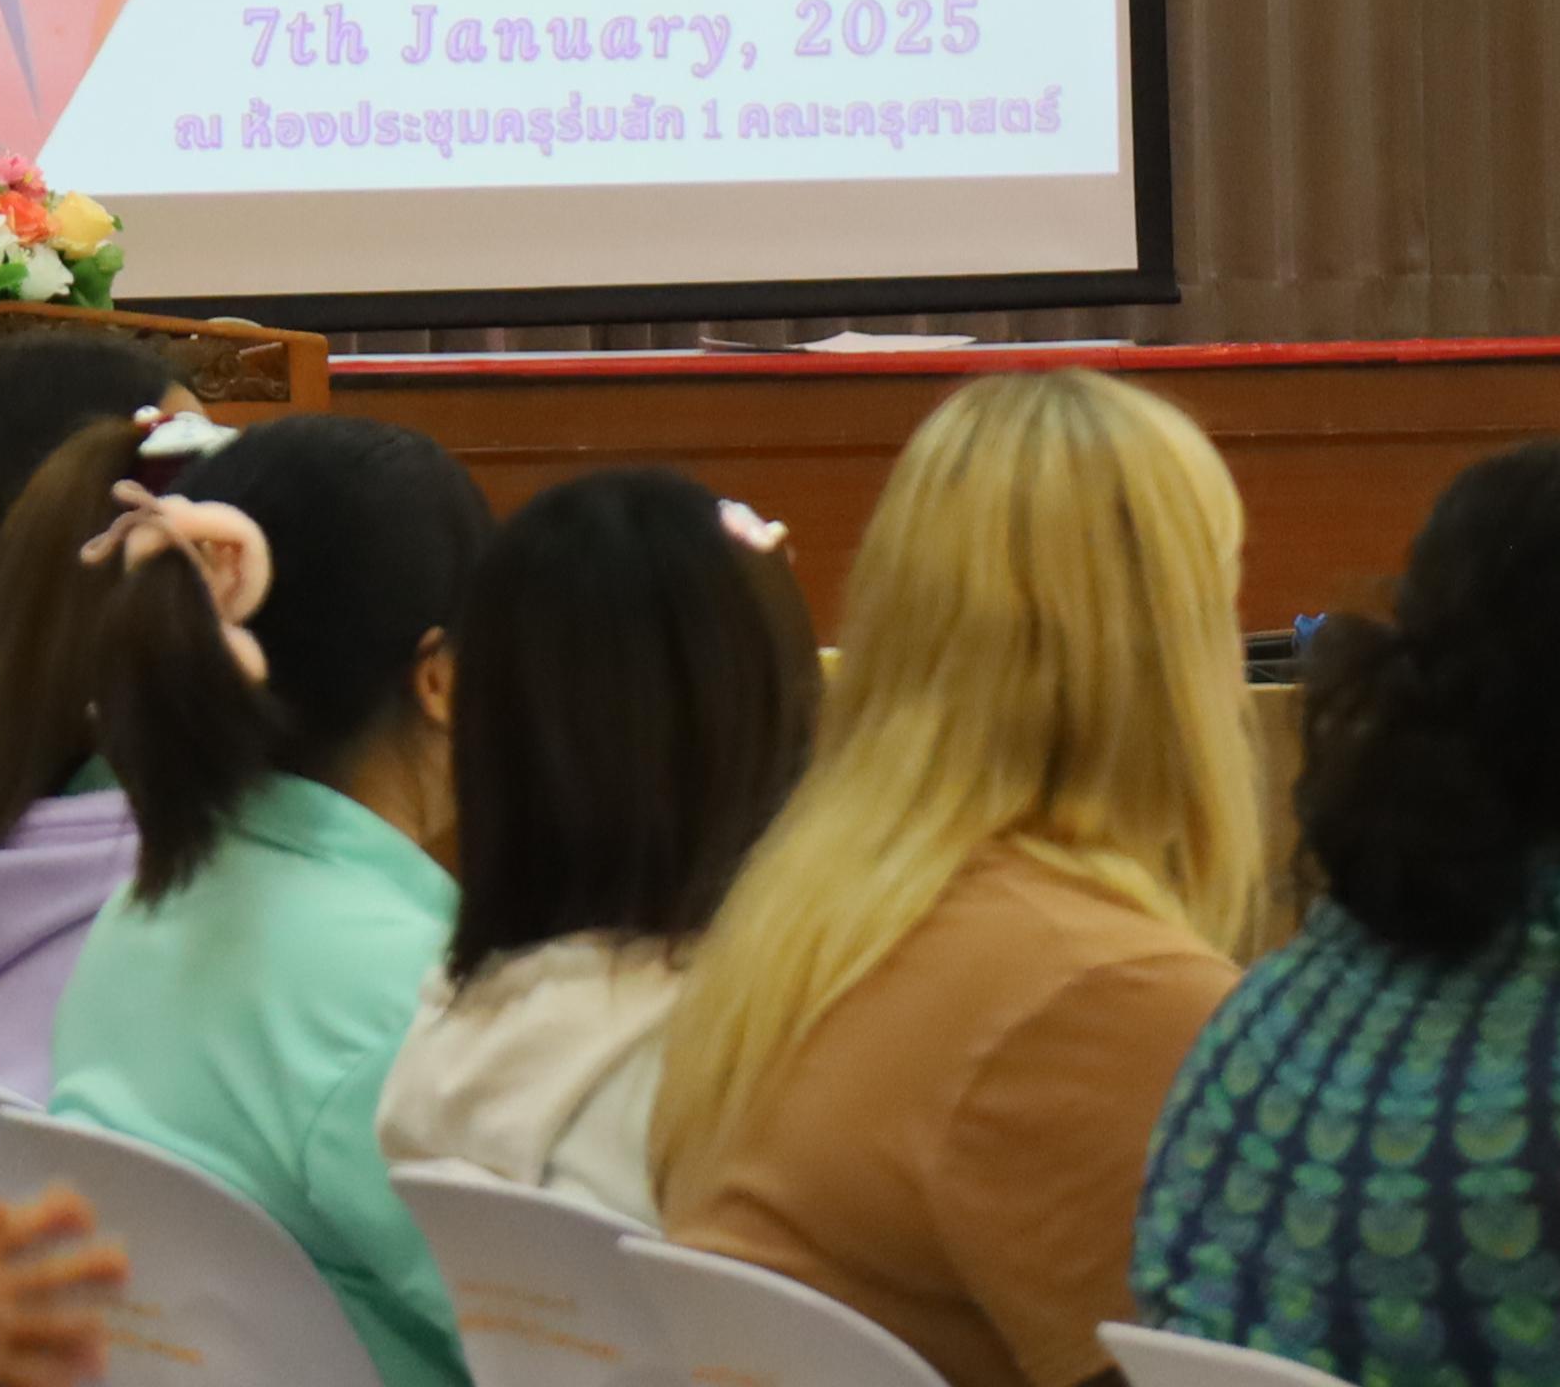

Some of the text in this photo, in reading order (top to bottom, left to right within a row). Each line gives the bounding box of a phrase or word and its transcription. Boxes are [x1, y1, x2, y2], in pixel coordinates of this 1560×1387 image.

[243, 3, 369, 68] 7th
[401, 5, 757, 79] January,
[175, 115, 223, 151] ณ
[702, 99, 722, 140] 1
[738, 85, 1062, 150] คณะครุศาสตร์
